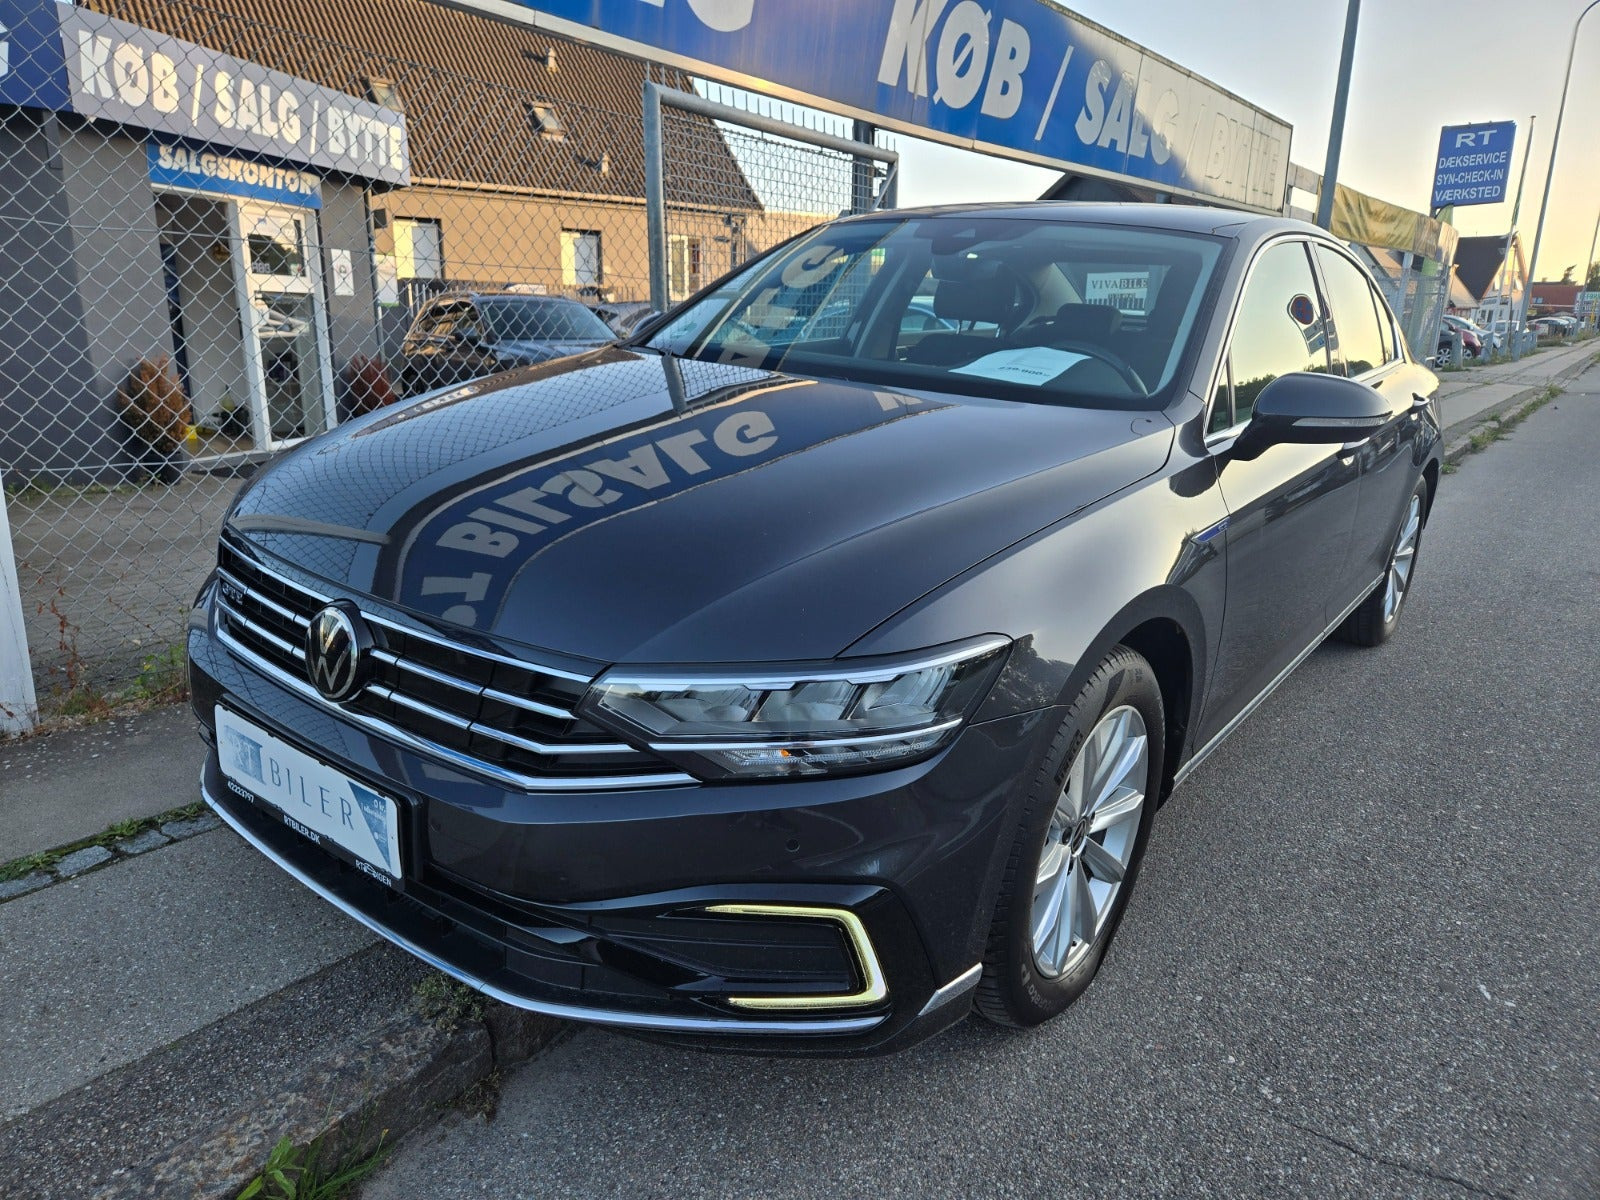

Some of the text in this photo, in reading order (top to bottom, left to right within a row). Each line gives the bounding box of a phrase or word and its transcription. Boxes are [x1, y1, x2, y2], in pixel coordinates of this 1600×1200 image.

[878, 0, 1031, 118] KØB
[78, 29, 180, 114] KØB
[213, 71, 302, 145] SALG
[327, 105, 403, 171] BYTTE
[1455, 129, 1498, 148] RT
[157, 144, 312, 196] SALGSKONTOR
[1436, 169, 1504, 185] SYN-CHECK-IN
[1438, 151, 1507, 168] DÆKSERVICE
[1434, 185, 1501, 201] VÆRKSTED
[269, 757, 355, 831] BILER
